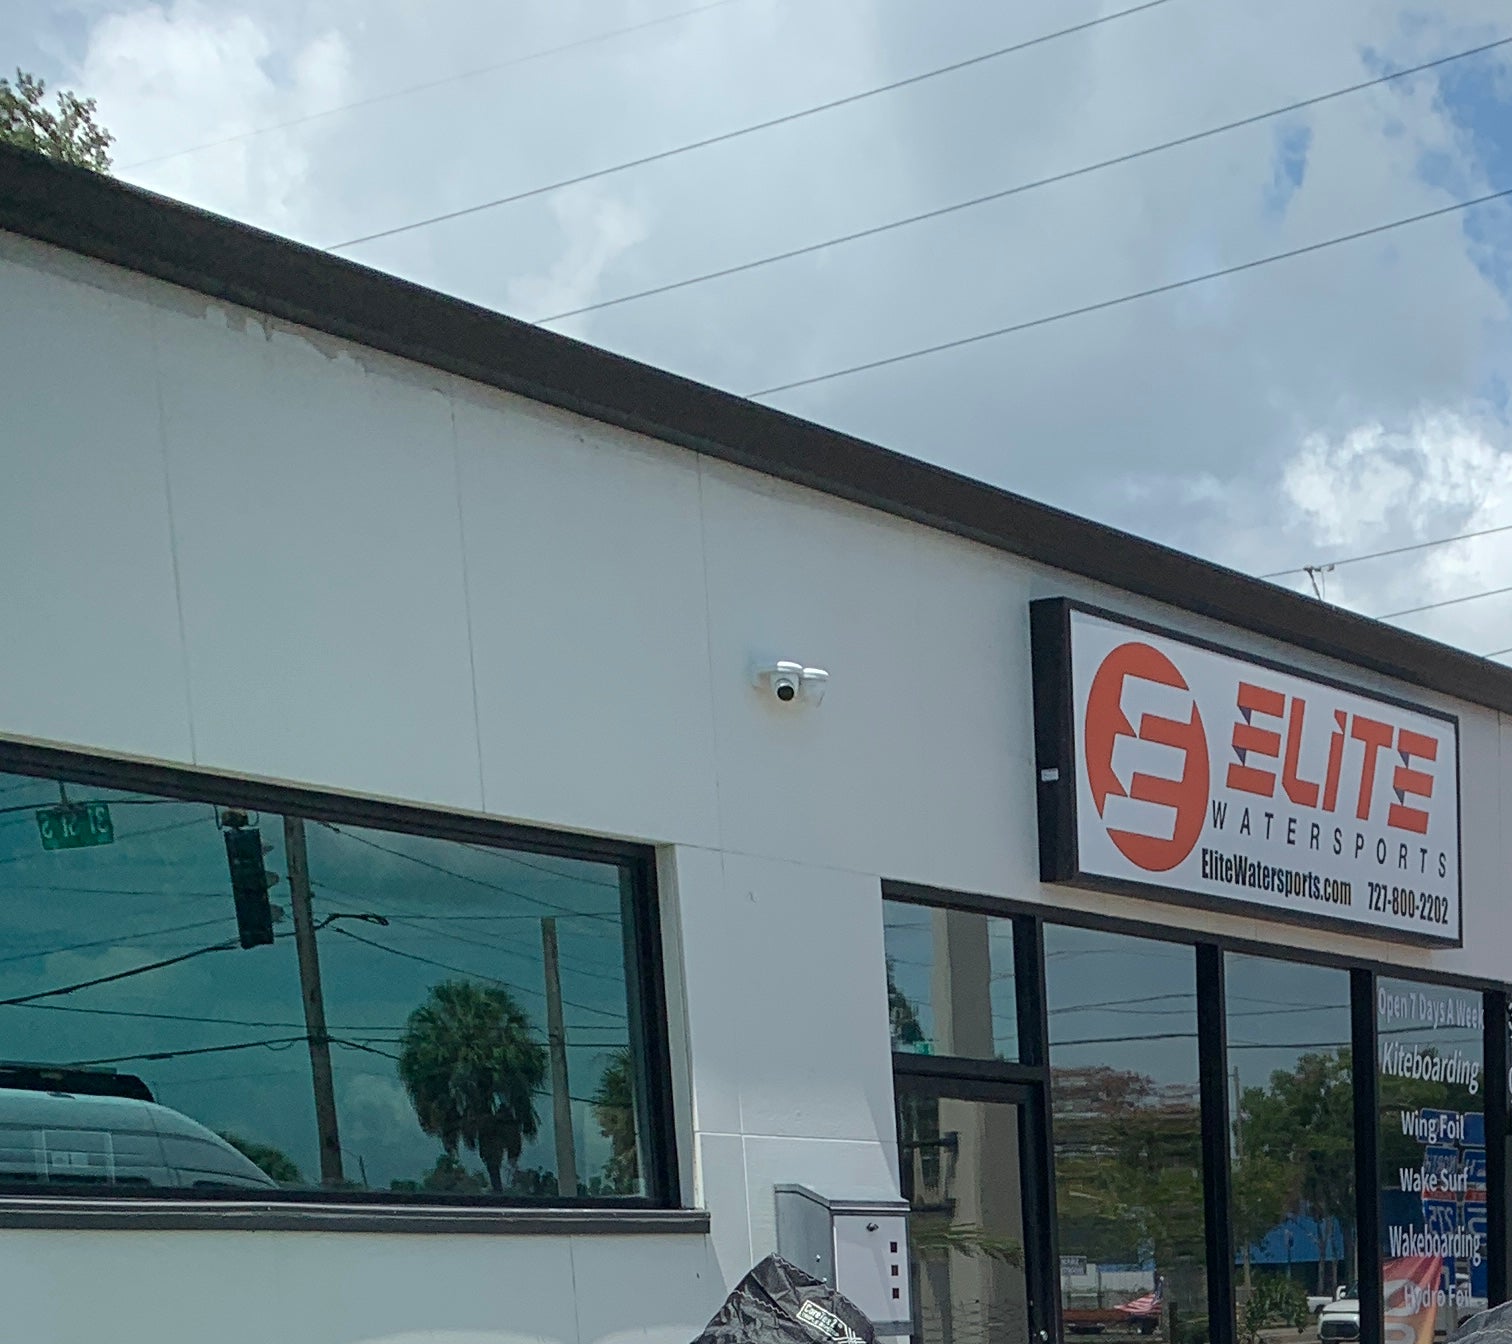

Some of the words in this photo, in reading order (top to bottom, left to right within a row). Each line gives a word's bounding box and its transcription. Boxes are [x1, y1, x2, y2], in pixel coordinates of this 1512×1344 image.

[1211, 800, 1447, 879] WATERSPORTS
[1201, 848, 1352, 906] EliteWatersports.com
[1368, 882, 1449, 925] 727-800-2202
[1378, 987, 1408, 1023] Open
[1409, 993, 1417, 1019] 7
[1419, 993, 1445, 1029] Days
[1446, 998, 1454, 1025] A
[1455, 999, 1484, 1030] Week
[1382, 1041, 1480, 1095] Kiteboarding
[1401, 1110, 1438, 1144] Wing
[1440, 1114, 1465, 1140] Foil
[1399, 1166, 1438, 1192] Wake
[1440, 1166, 1469, 1192] Surf
[1389, 1223, 1481, 1267] Wakeboarding
[1404, 1282, 1446, 1314] Hydro
[1449, 1282, 1472, 1308] Foil
